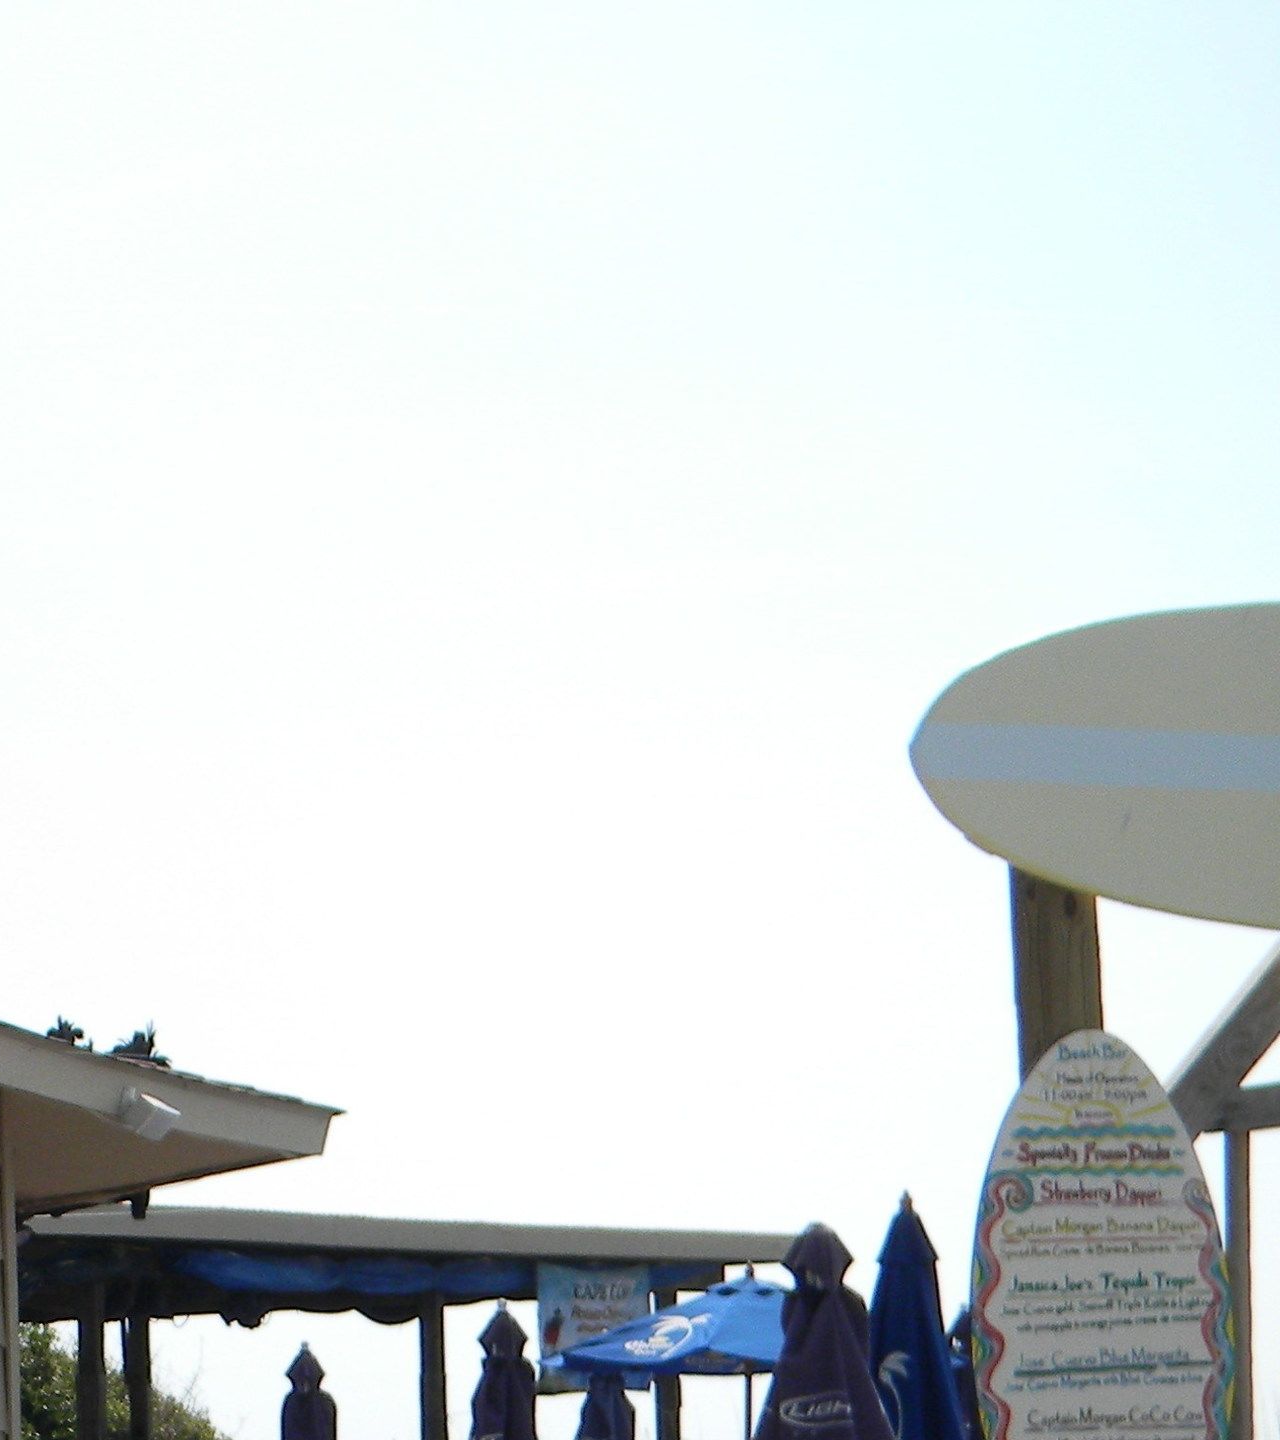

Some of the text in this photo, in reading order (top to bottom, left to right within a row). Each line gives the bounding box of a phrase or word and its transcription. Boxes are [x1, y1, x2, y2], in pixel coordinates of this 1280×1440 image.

[1040, 1179, 1111, 1203] Strawberry
[1027, 1408, 1077, 1428] Captain
[1079, 1406, 1127, 1427] Morgan
